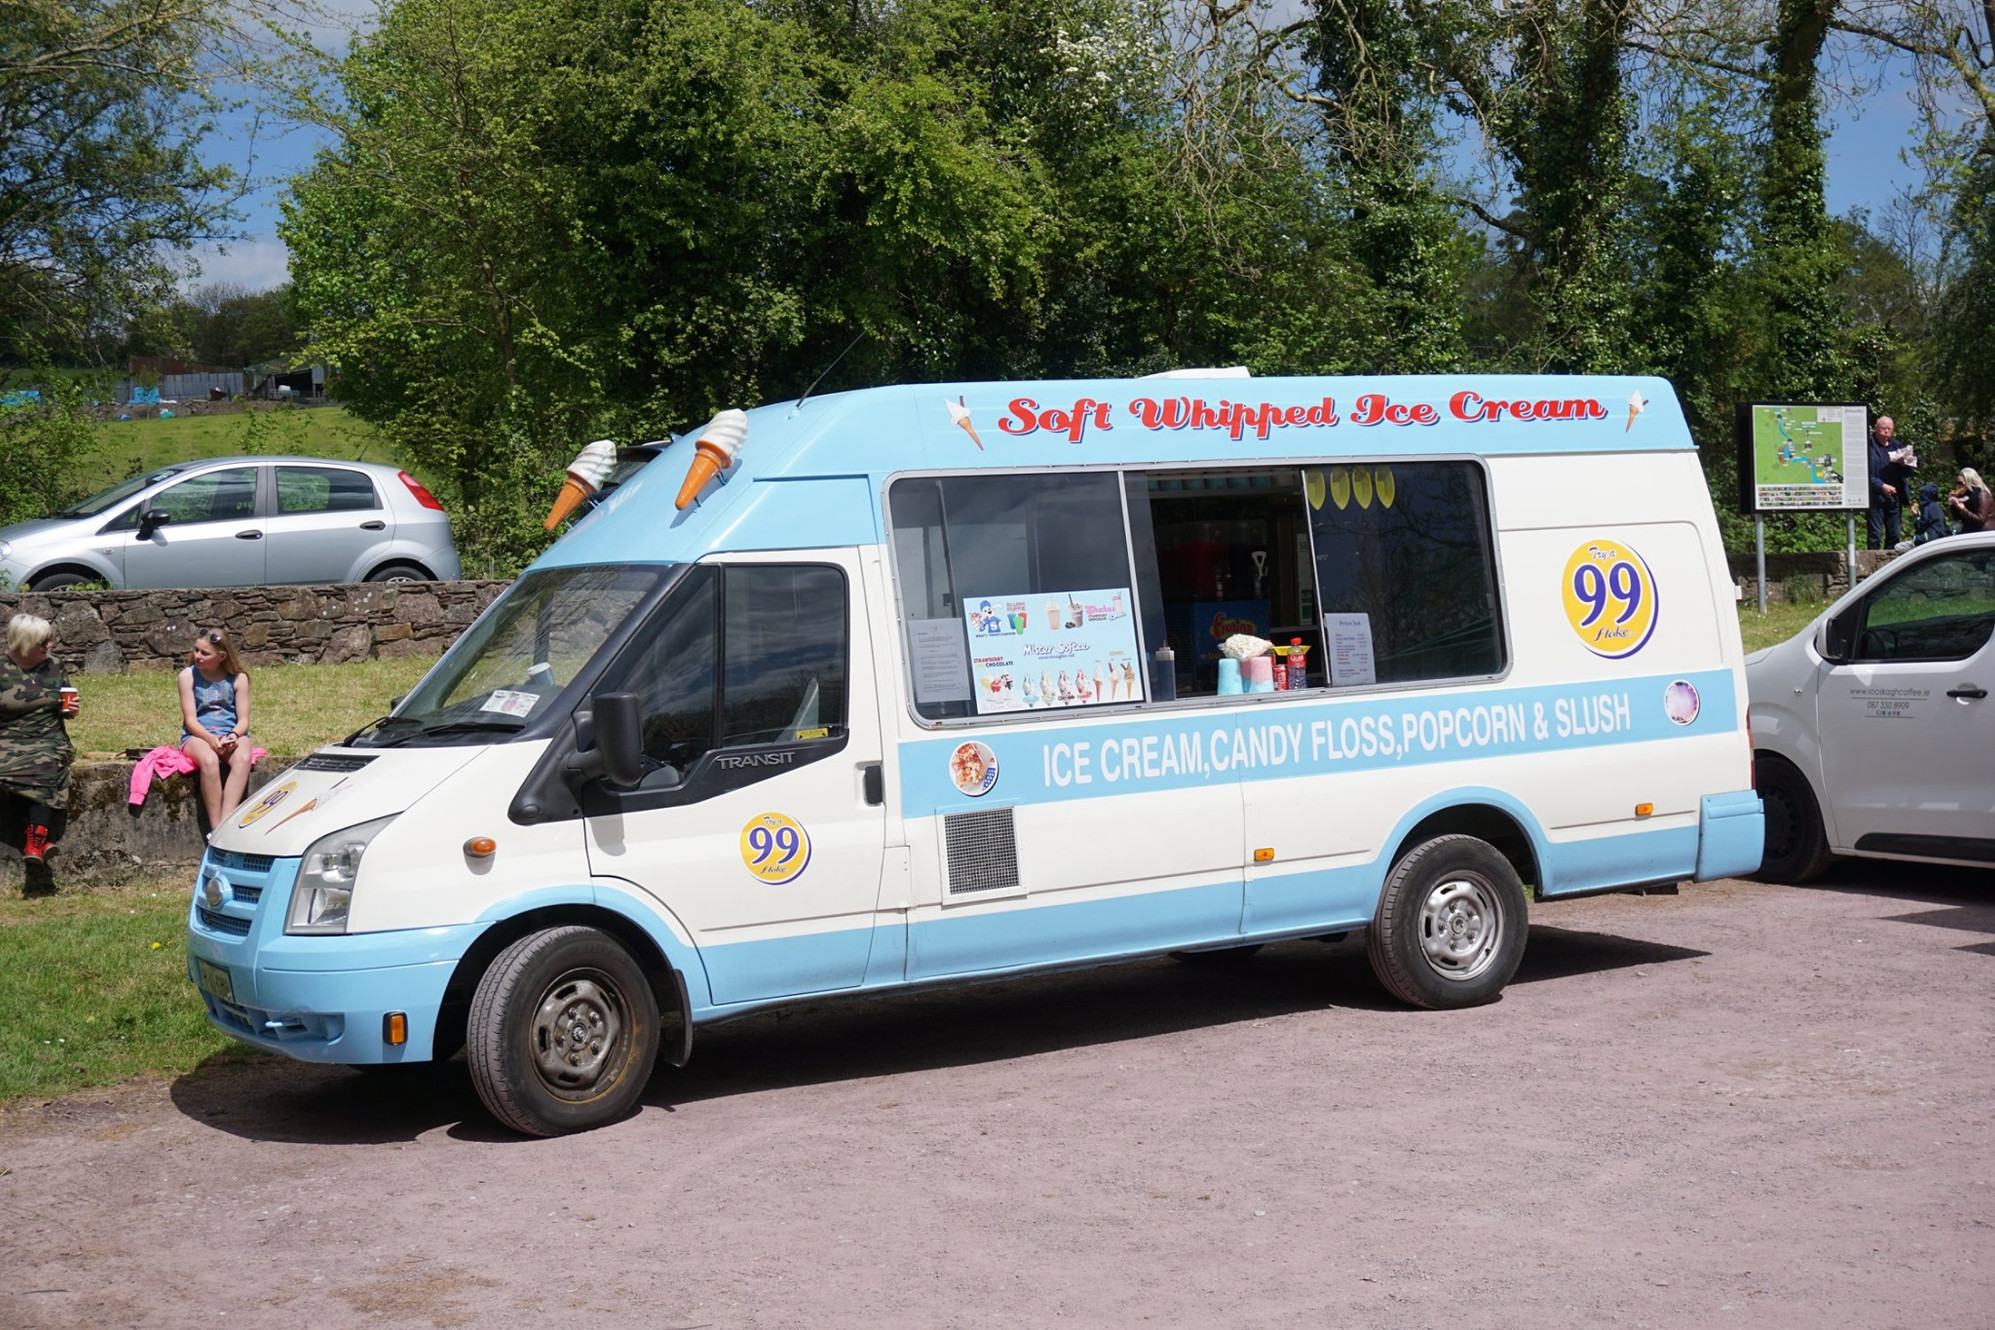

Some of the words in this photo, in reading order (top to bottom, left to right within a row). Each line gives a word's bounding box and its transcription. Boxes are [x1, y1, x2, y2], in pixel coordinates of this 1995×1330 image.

[998, 397, 1113, 443] Soft
[1128, 396, 1340, 441] Whipped
[1350, 393, 1441, 427] Ice
[1449, 390, 1609, 423] Cream
[1588, 546, 1607, 561] Try
[1573, 562, 1642, 627] 99
[717, 752, 795, 770] TRANSIT
[1043, 741, 1093, 788] ICE
[1533, 701, 1550, 741] &
[1555, 692, 1631, 738] SLUSH
[749, 827, 800, 865] 99
